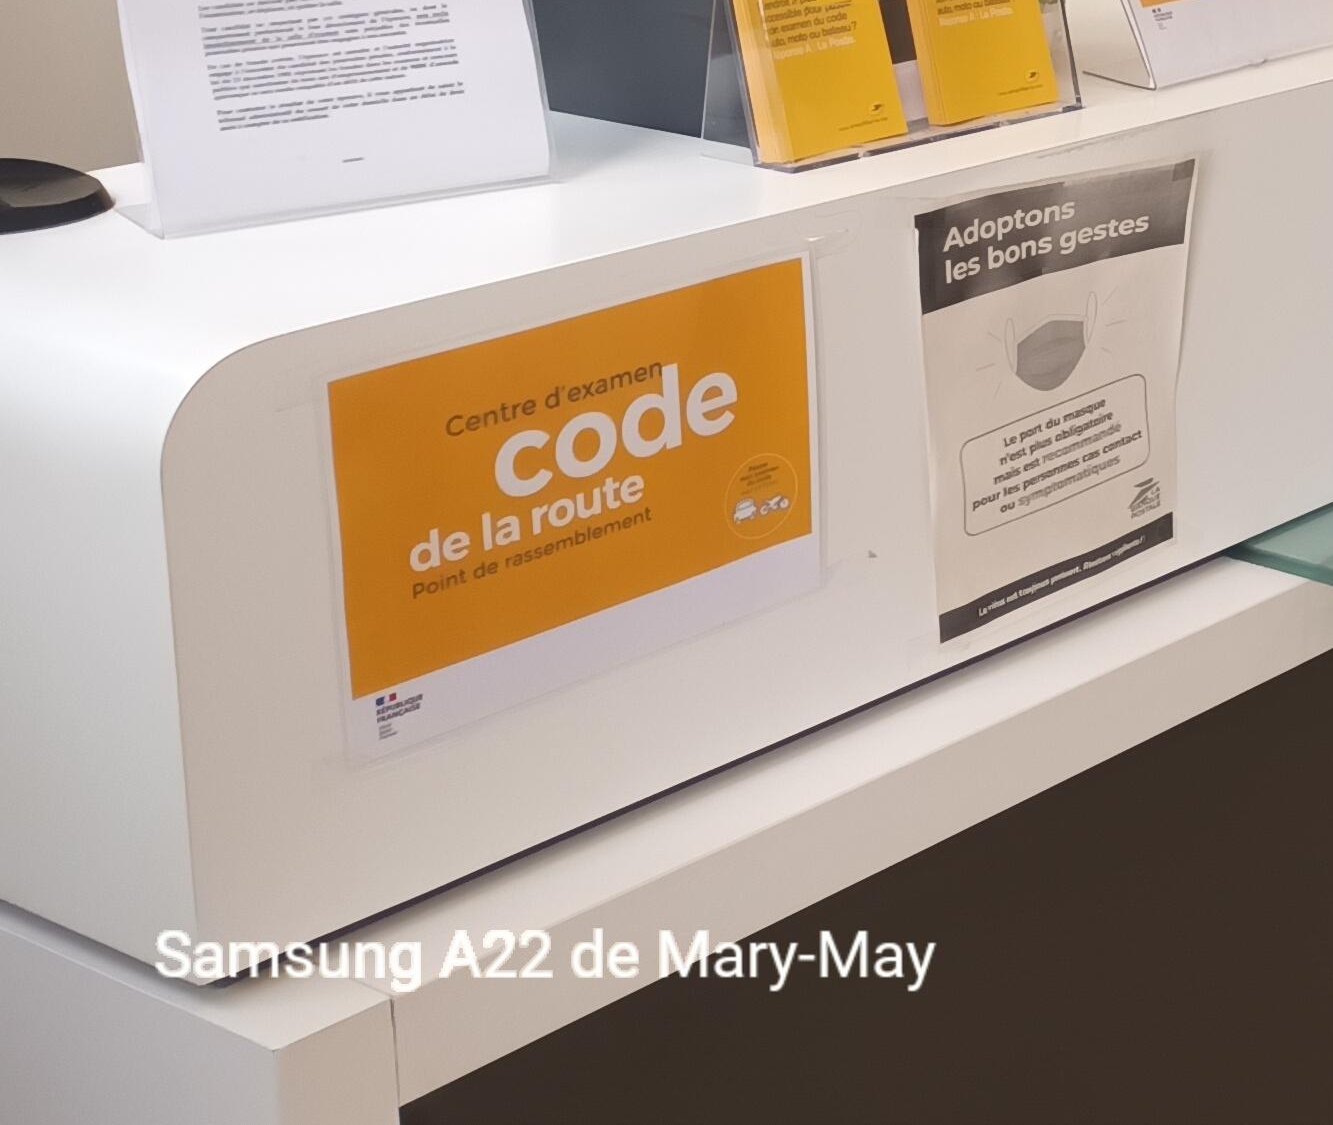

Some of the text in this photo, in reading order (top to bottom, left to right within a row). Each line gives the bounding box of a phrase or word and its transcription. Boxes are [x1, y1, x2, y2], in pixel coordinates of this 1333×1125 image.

[942, 201, 1076, 252] Adoptons
[945, 215, 1149, 284] les bons gestes
[445, 361, 664, 437] Centre d'examen
[494, 362, 738, 498] code
[1003, 398, 1106, 448] Le port du masque
[972, 429, 1143, 512] pour les personnes cas contact
[993, 466, 1022, 485] mais
[1023, 457, 1040, 472] est
[998, 410, 1114, 466] n'est plus obligatoire
[409, 474, 645, 573] de la route
[1000, 500, 1016, 514] ou
[412, 506, 653, 600] Point de rassemblement
